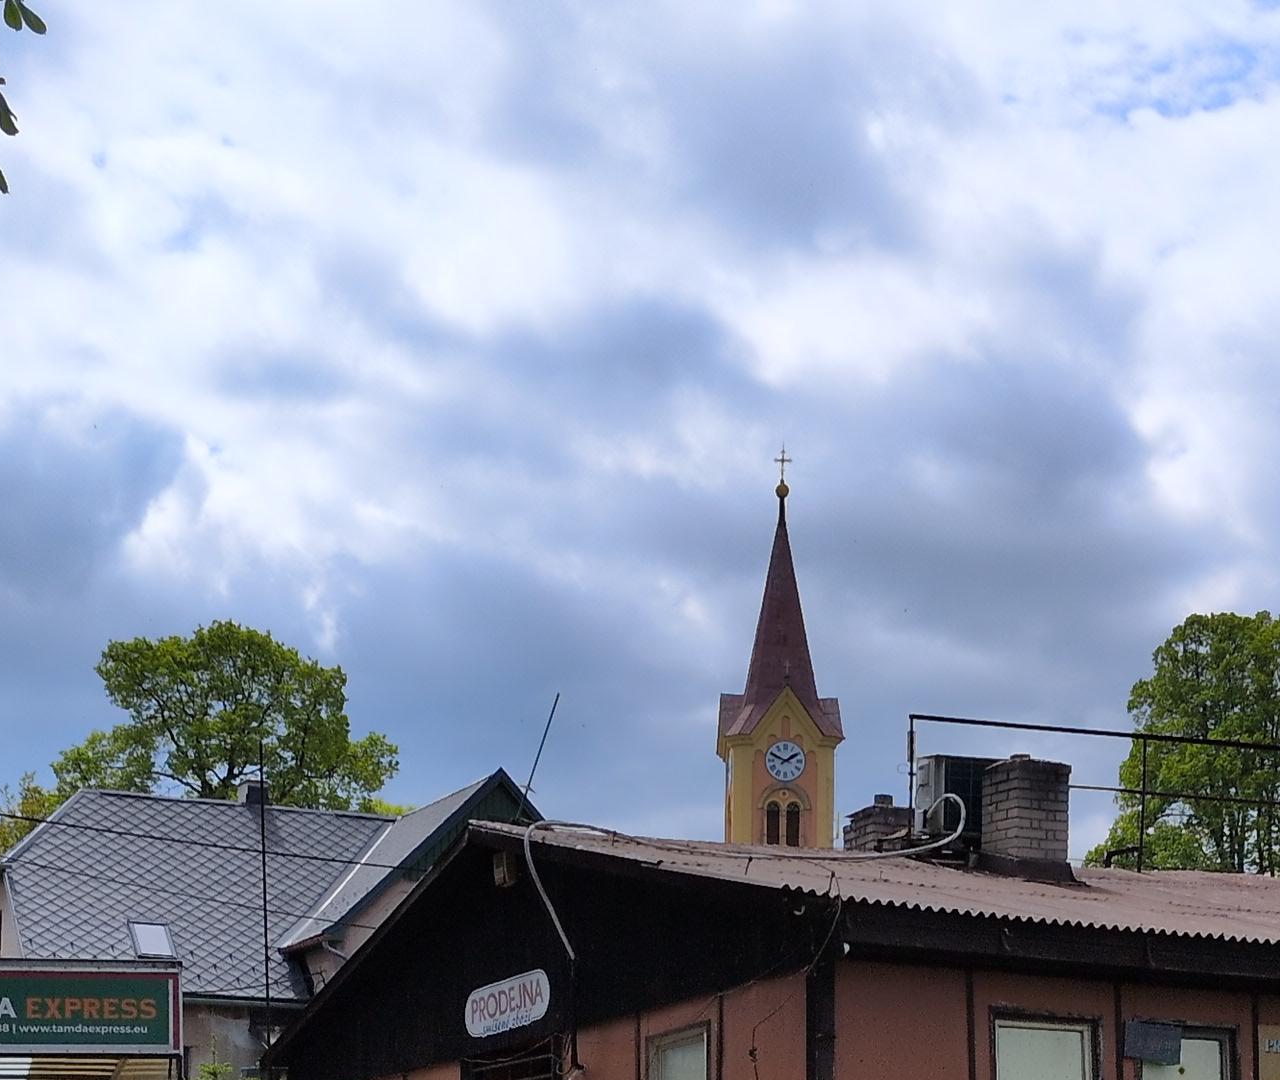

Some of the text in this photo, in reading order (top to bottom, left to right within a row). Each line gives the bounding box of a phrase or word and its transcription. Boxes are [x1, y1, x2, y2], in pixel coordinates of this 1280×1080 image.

[26, 997, 157, 1020] EXPRESS
[471, 978, 544, 1025] PRODEJNA
[19, 1023, 148, 1036] www.tamdaexpress.eu
